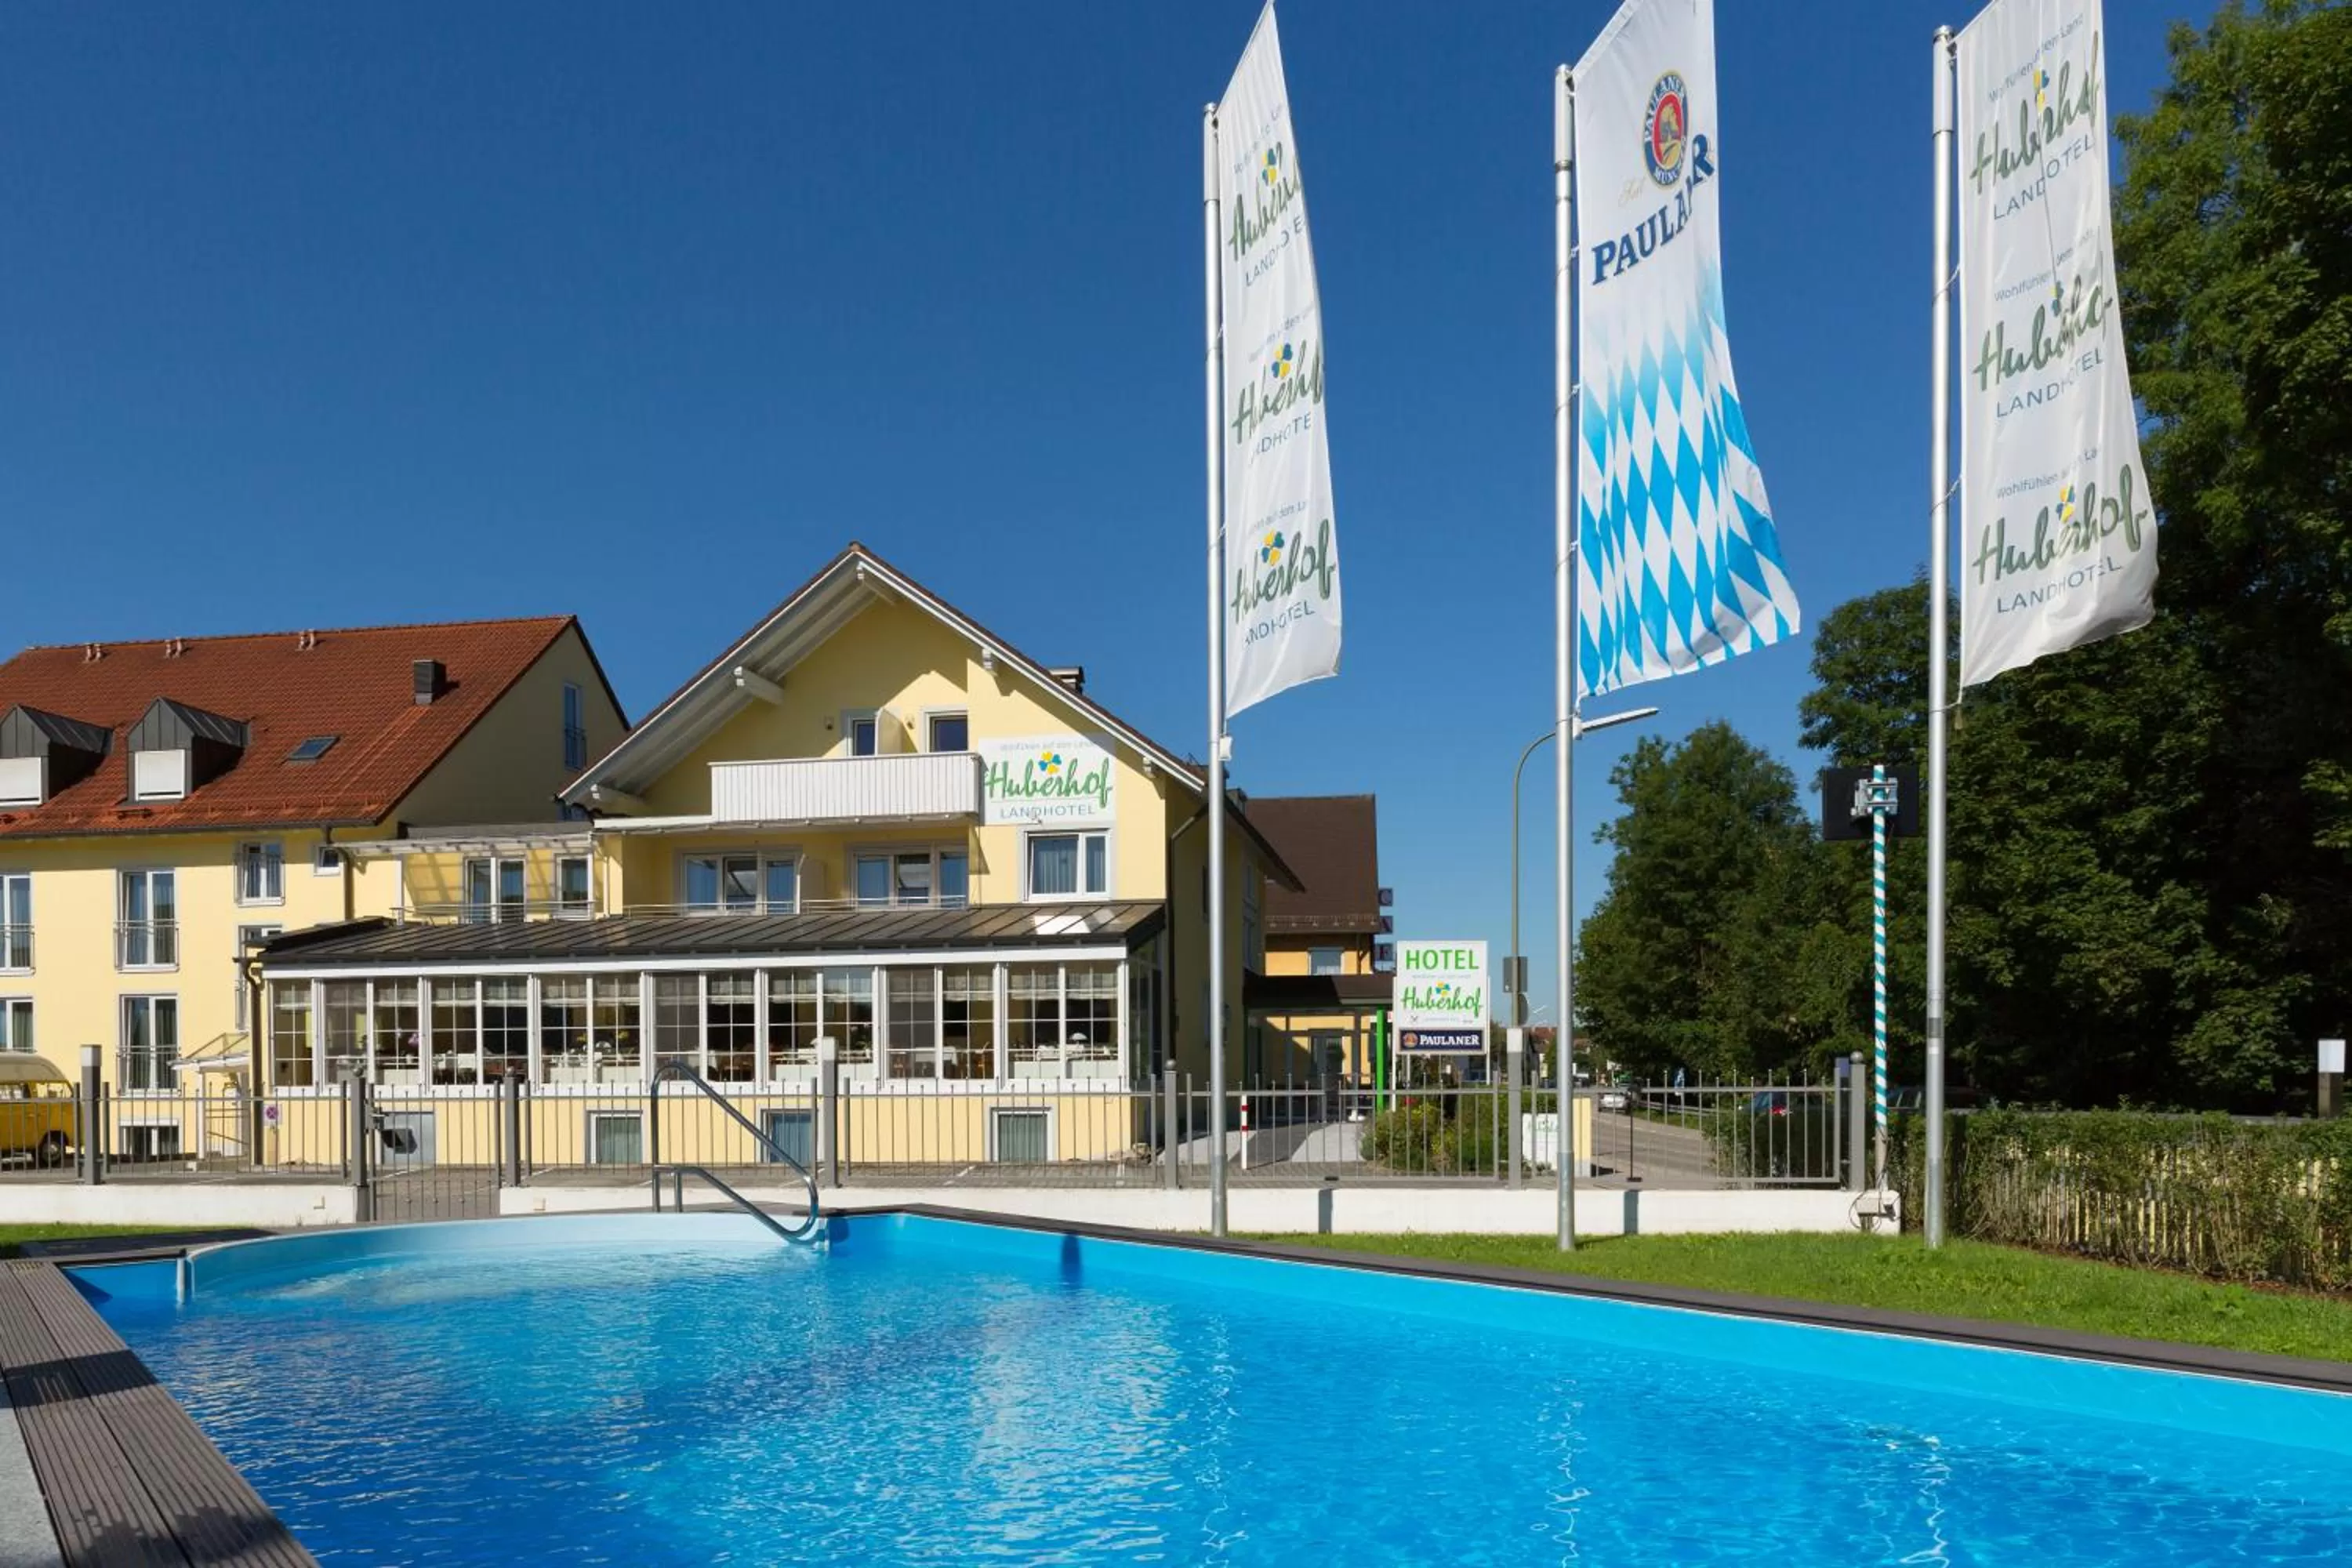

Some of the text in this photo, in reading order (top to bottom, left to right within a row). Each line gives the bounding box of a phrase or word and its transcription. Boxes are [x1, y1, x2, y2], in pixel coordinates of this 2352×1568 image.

[1994, 133, 2096, 220] LANDOTEL
[1592, 134, 1715, 286] PAULAR
[1231, 518, 1337, 624] Hberhof
[985, 757, 1113, 808] Huberhof
[1000, 804, 1095, 819] LANDHOTEL
[1406, 949, 1479, 970] HOTEL
[1400, 985, 1483, 1018] Huberhof
[1420, 1034, 1480, 1046] PAULANER
